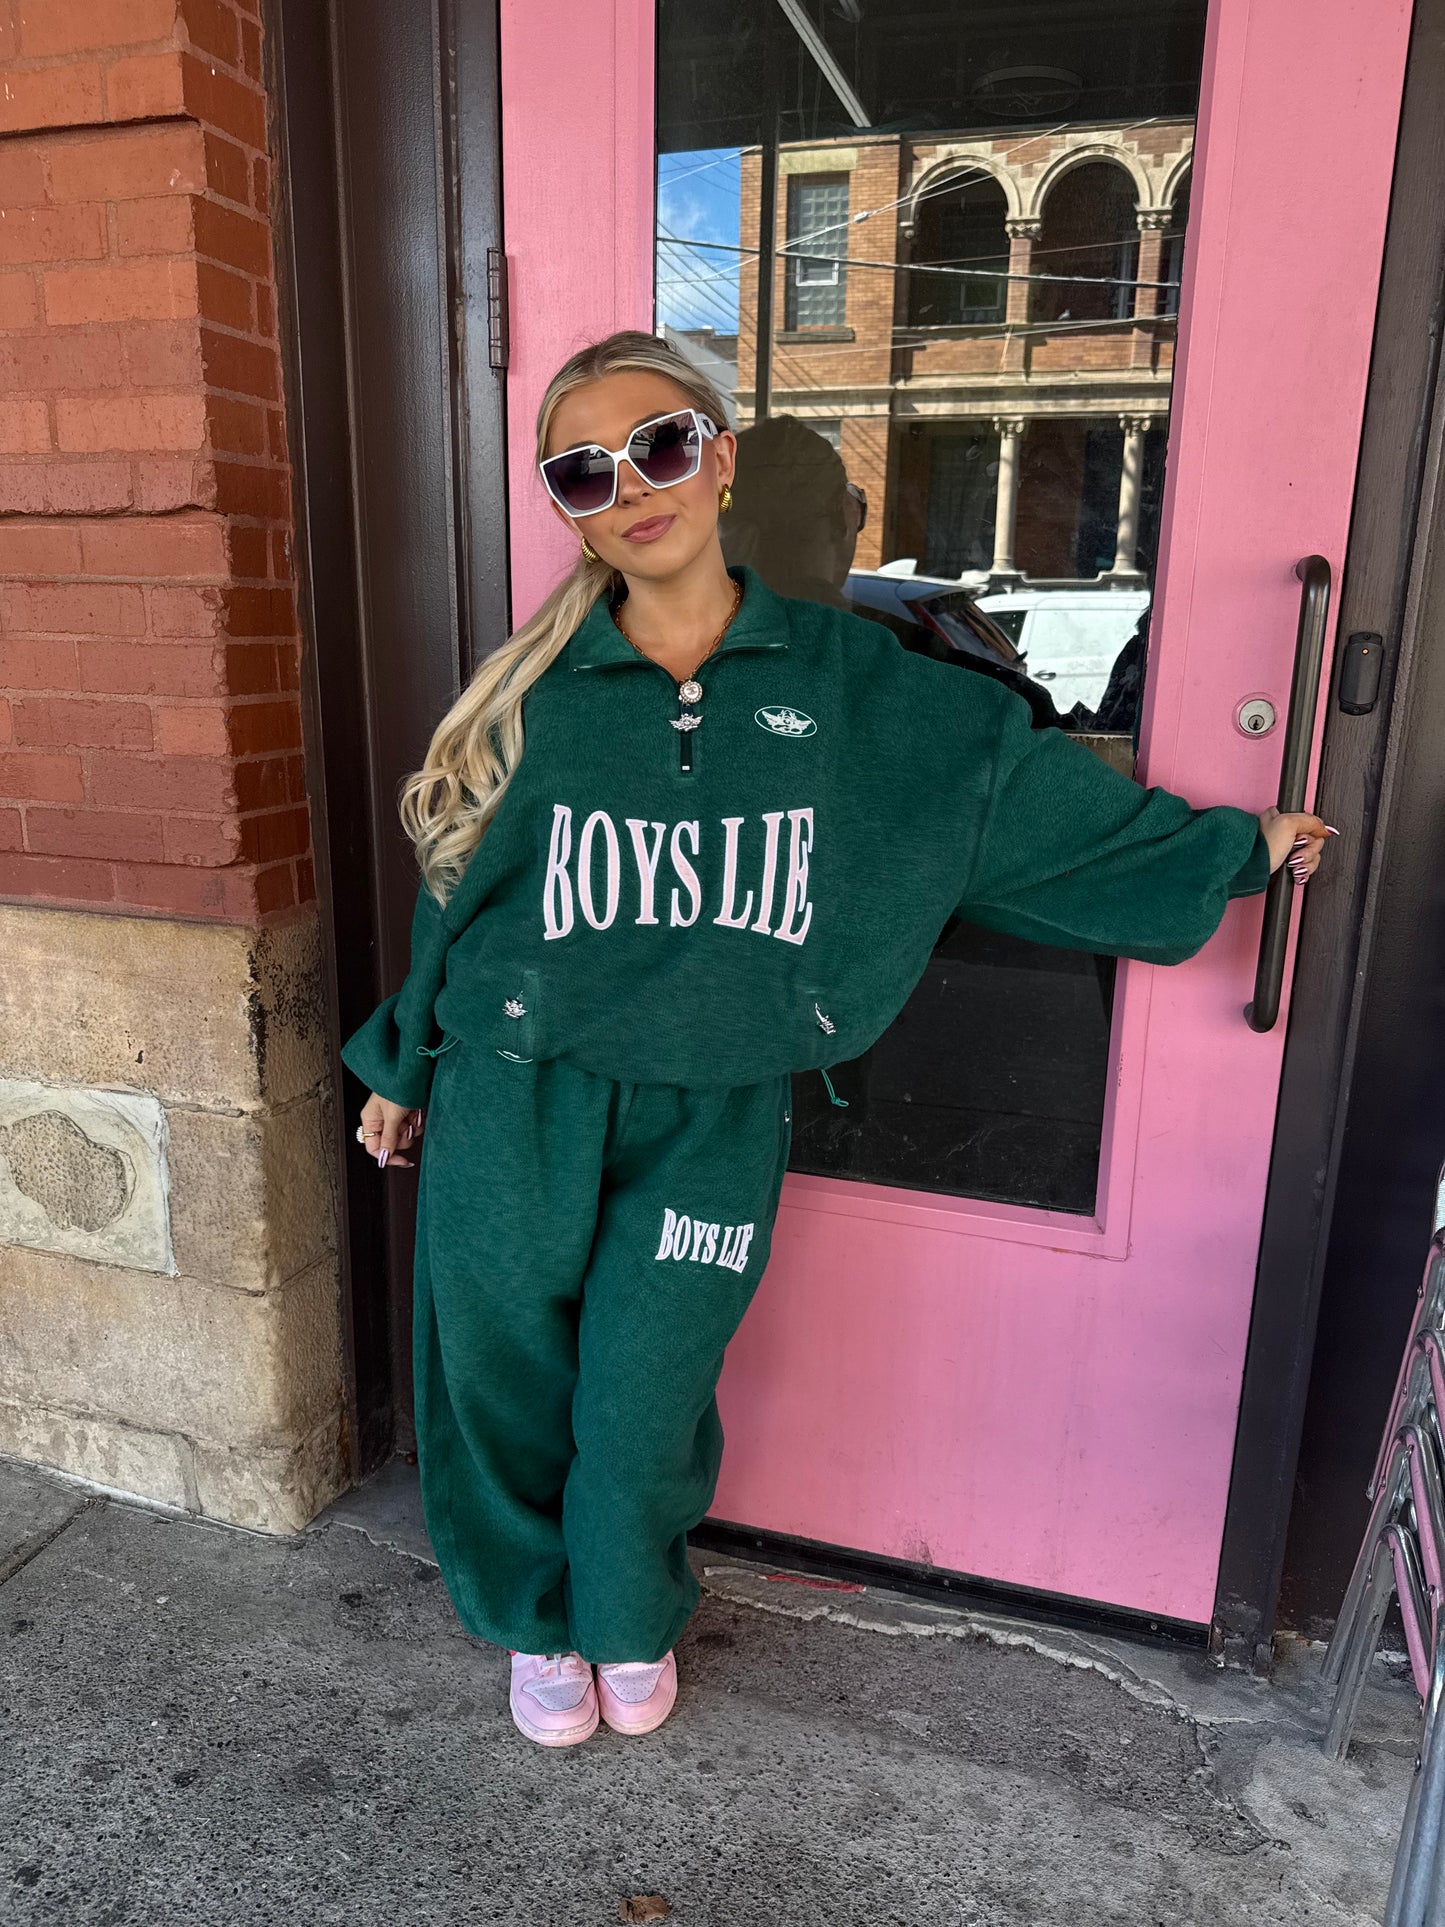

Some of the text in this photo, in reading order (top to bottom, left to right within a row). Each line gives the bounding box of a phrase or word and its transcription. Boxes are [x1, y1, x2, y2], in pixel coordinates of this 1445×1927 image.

[543, 803, 813, 945] BOYS LIE
[655, 1208, 754, 1274] BOYS LIE
